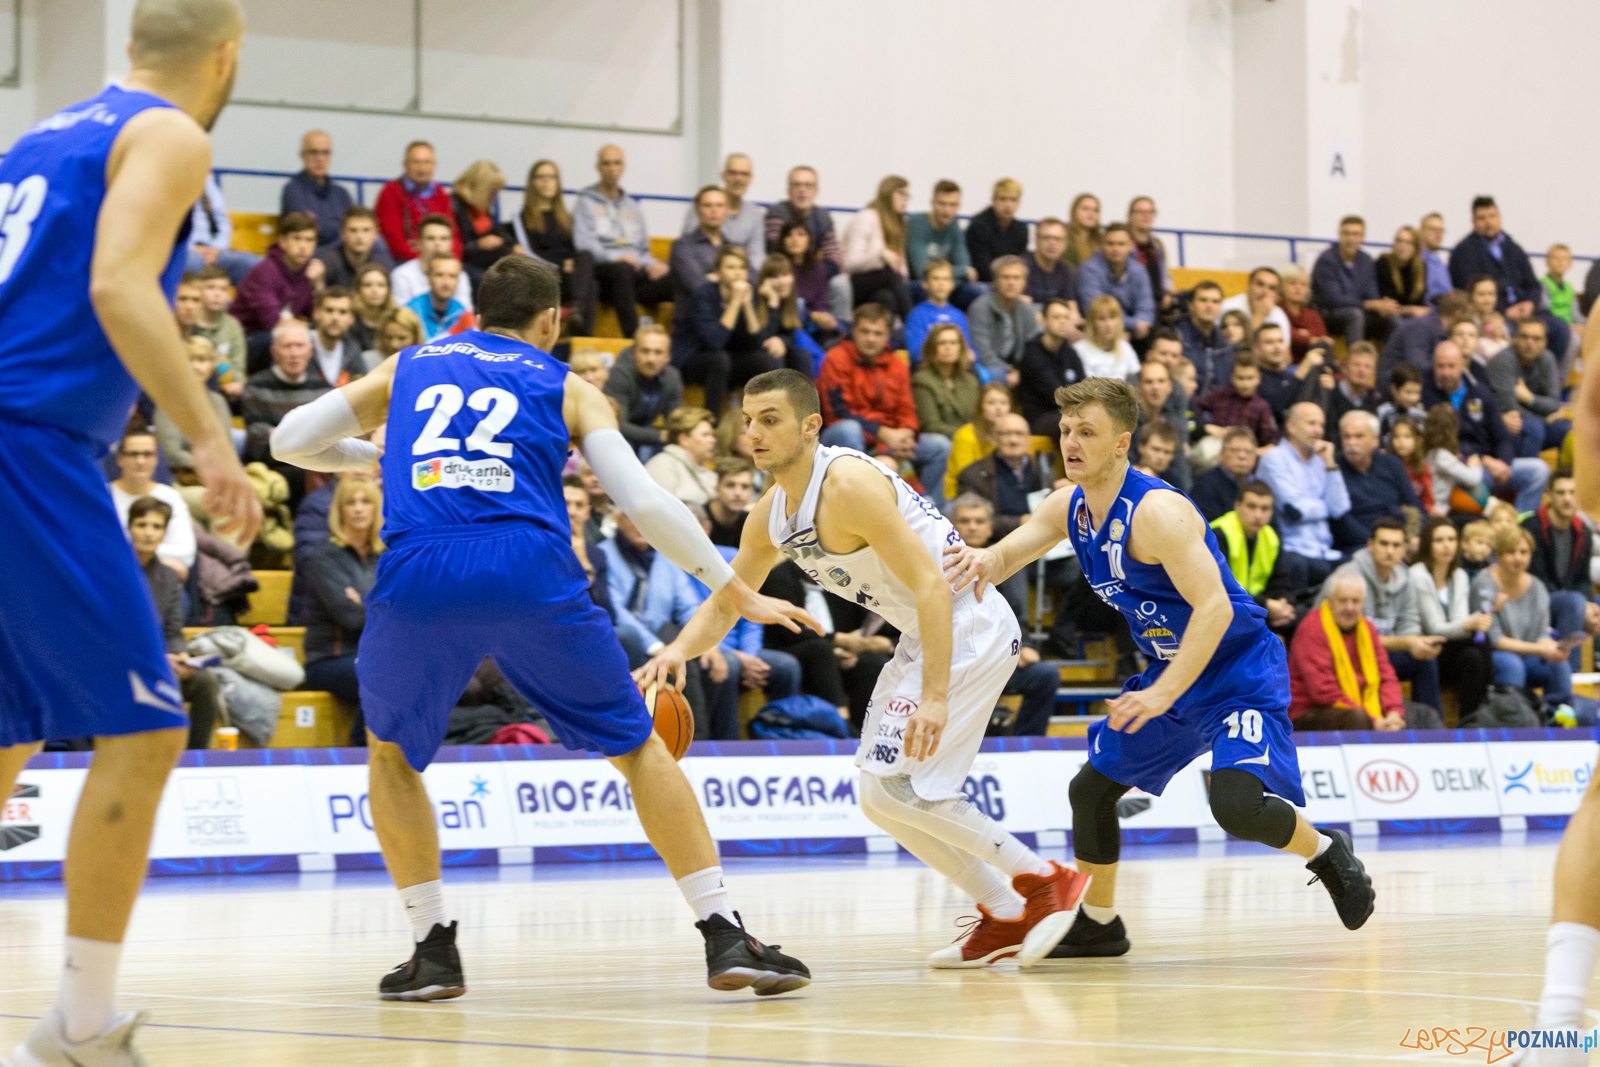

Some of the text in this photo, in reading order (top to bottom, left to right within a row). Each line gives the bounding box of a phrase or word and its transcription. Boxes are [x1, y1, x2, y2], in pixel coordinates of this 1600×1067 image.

[1330, 152, 1346, 177] A
[412, 384, 519, 459] 22
[1101, 540, 1126, 580] 10
[1222, 708, 1264, 744] 10
[703, 776, 858, 808] BIOFARM
[1366, 770, 1411, 793] KIA
[1430, 767, 1491, 792] DELIK
[4, 803, 33, 821] ER
